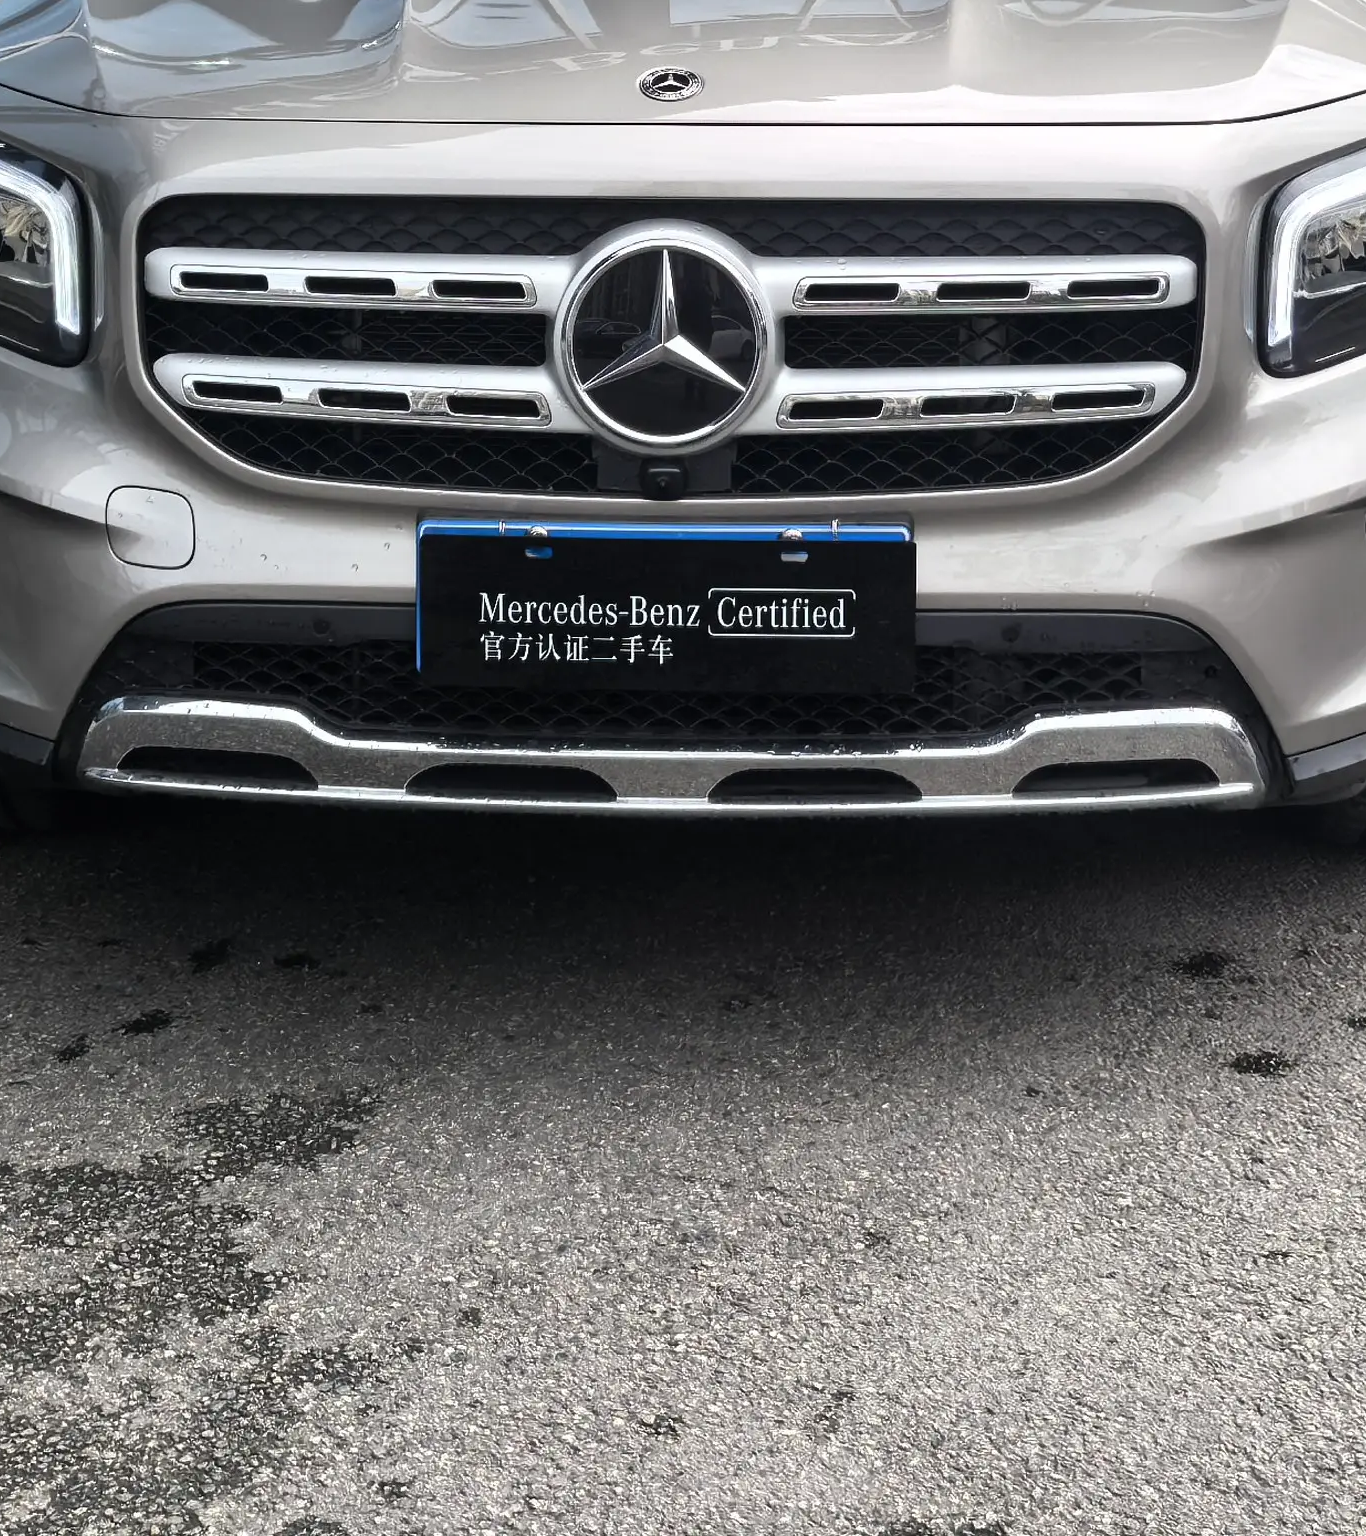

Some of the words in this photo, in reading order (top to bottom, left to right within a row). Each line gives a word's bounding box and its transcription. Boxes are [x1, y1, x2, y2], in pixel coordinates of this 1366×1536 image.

[478, 591, 701, 628] Mercedes-Benz
[717, 596, 846, 629] Certified
[480, 630, 674, 665] 官方认证二手车
